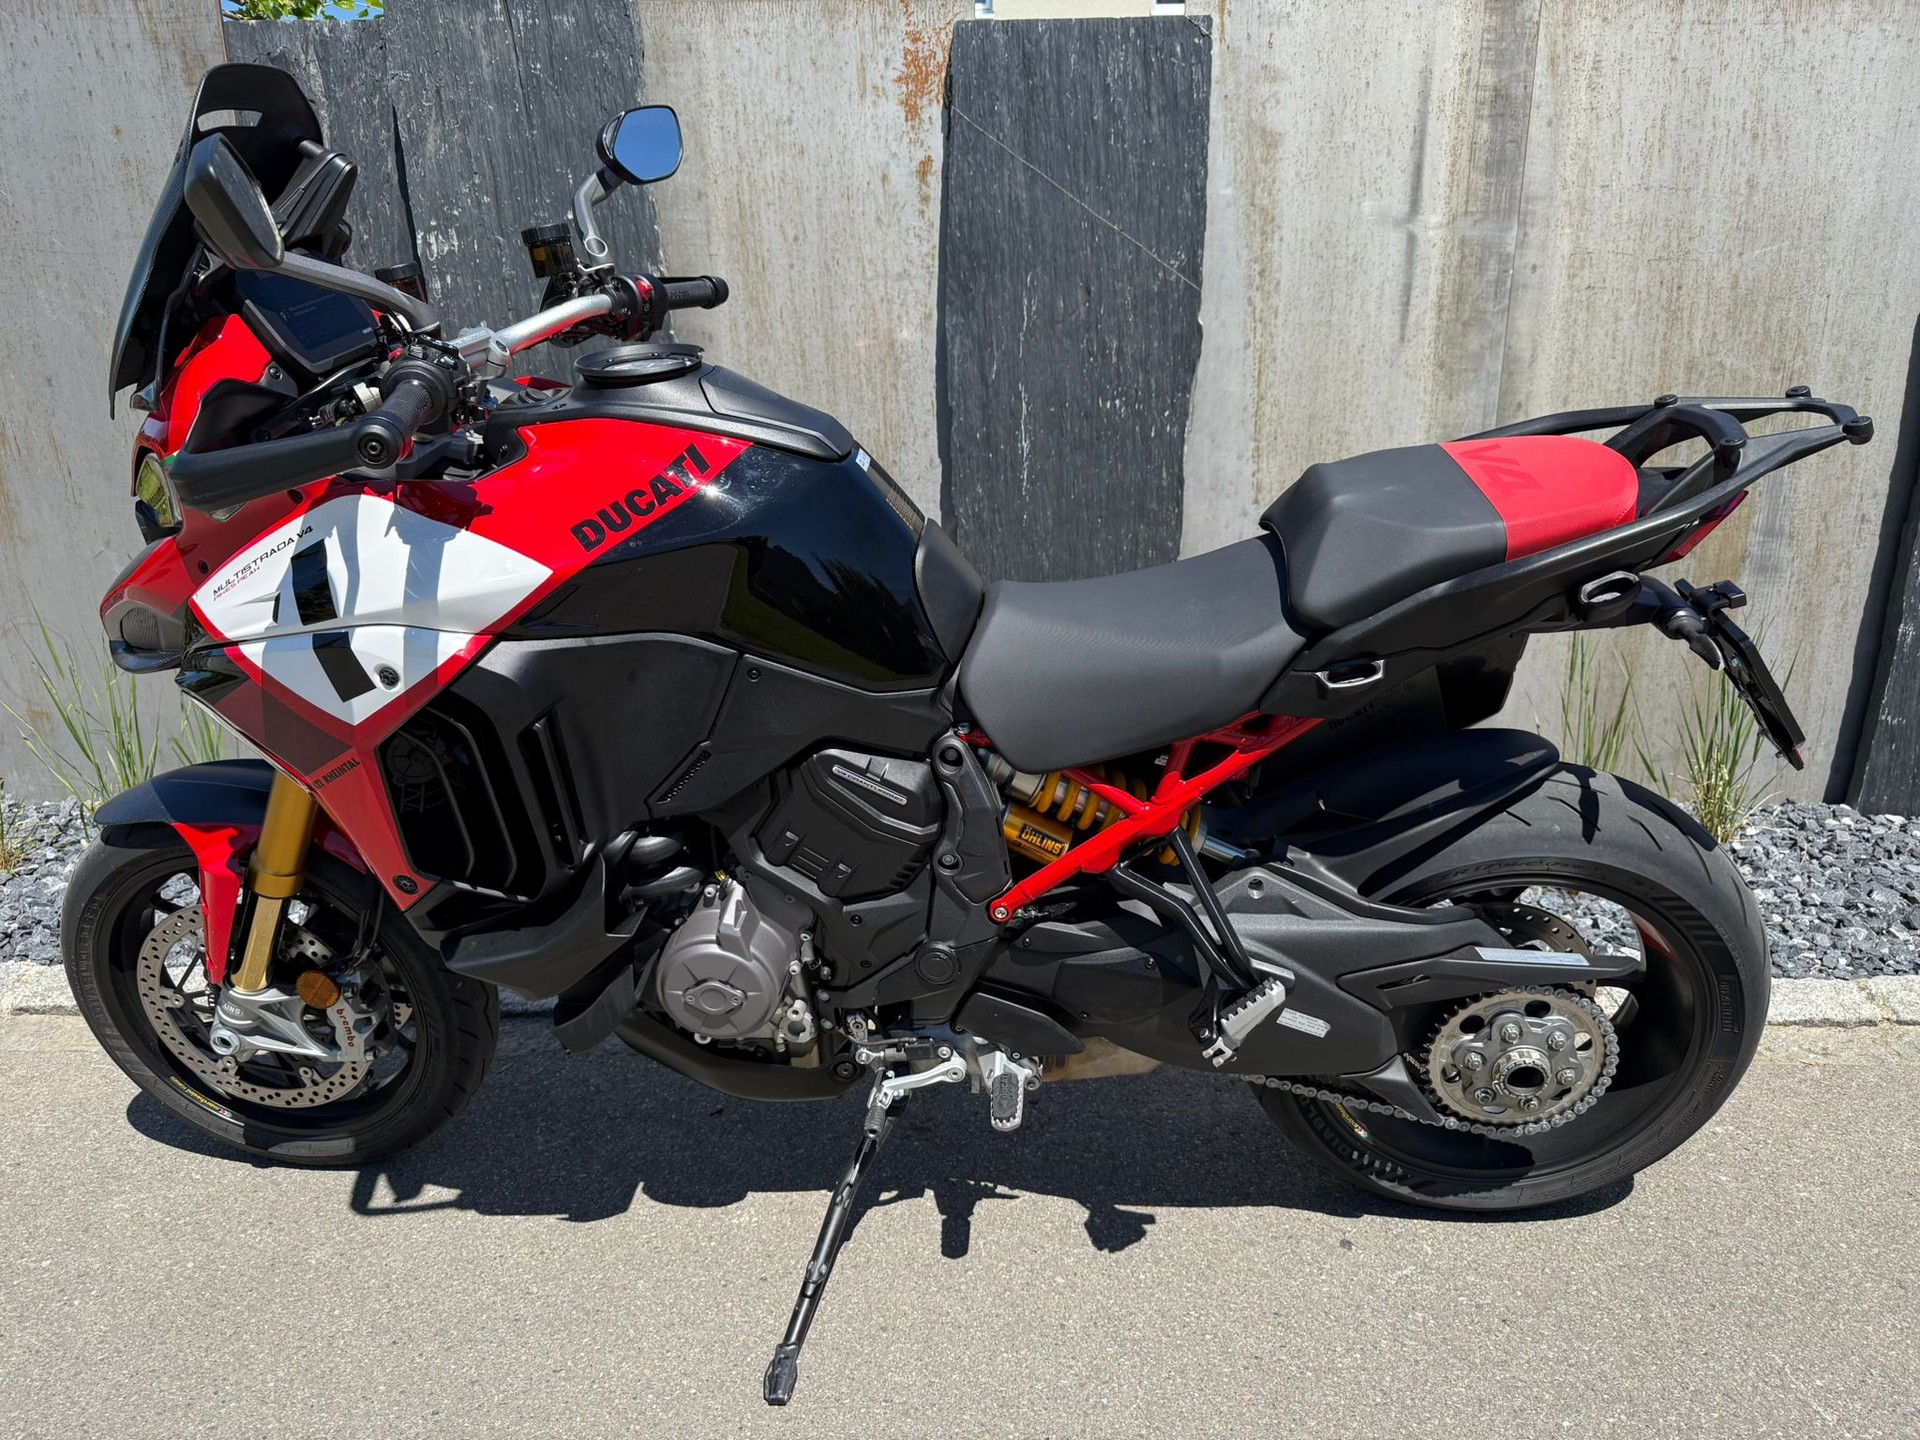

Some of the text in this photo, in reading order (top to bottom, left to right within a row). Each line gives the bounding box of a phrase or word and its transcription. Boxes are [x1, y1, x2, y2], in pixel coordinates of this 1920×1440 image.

[570, 442, 711, 553] DUCATI
[213, 525, 314, 597] MULTISTRADA V4
[322, 757, 361, 784] RHEINTAL
[1021, 825, 1062, 855] ÖHLINS
[336, 1008, 356, 1048] brembo
